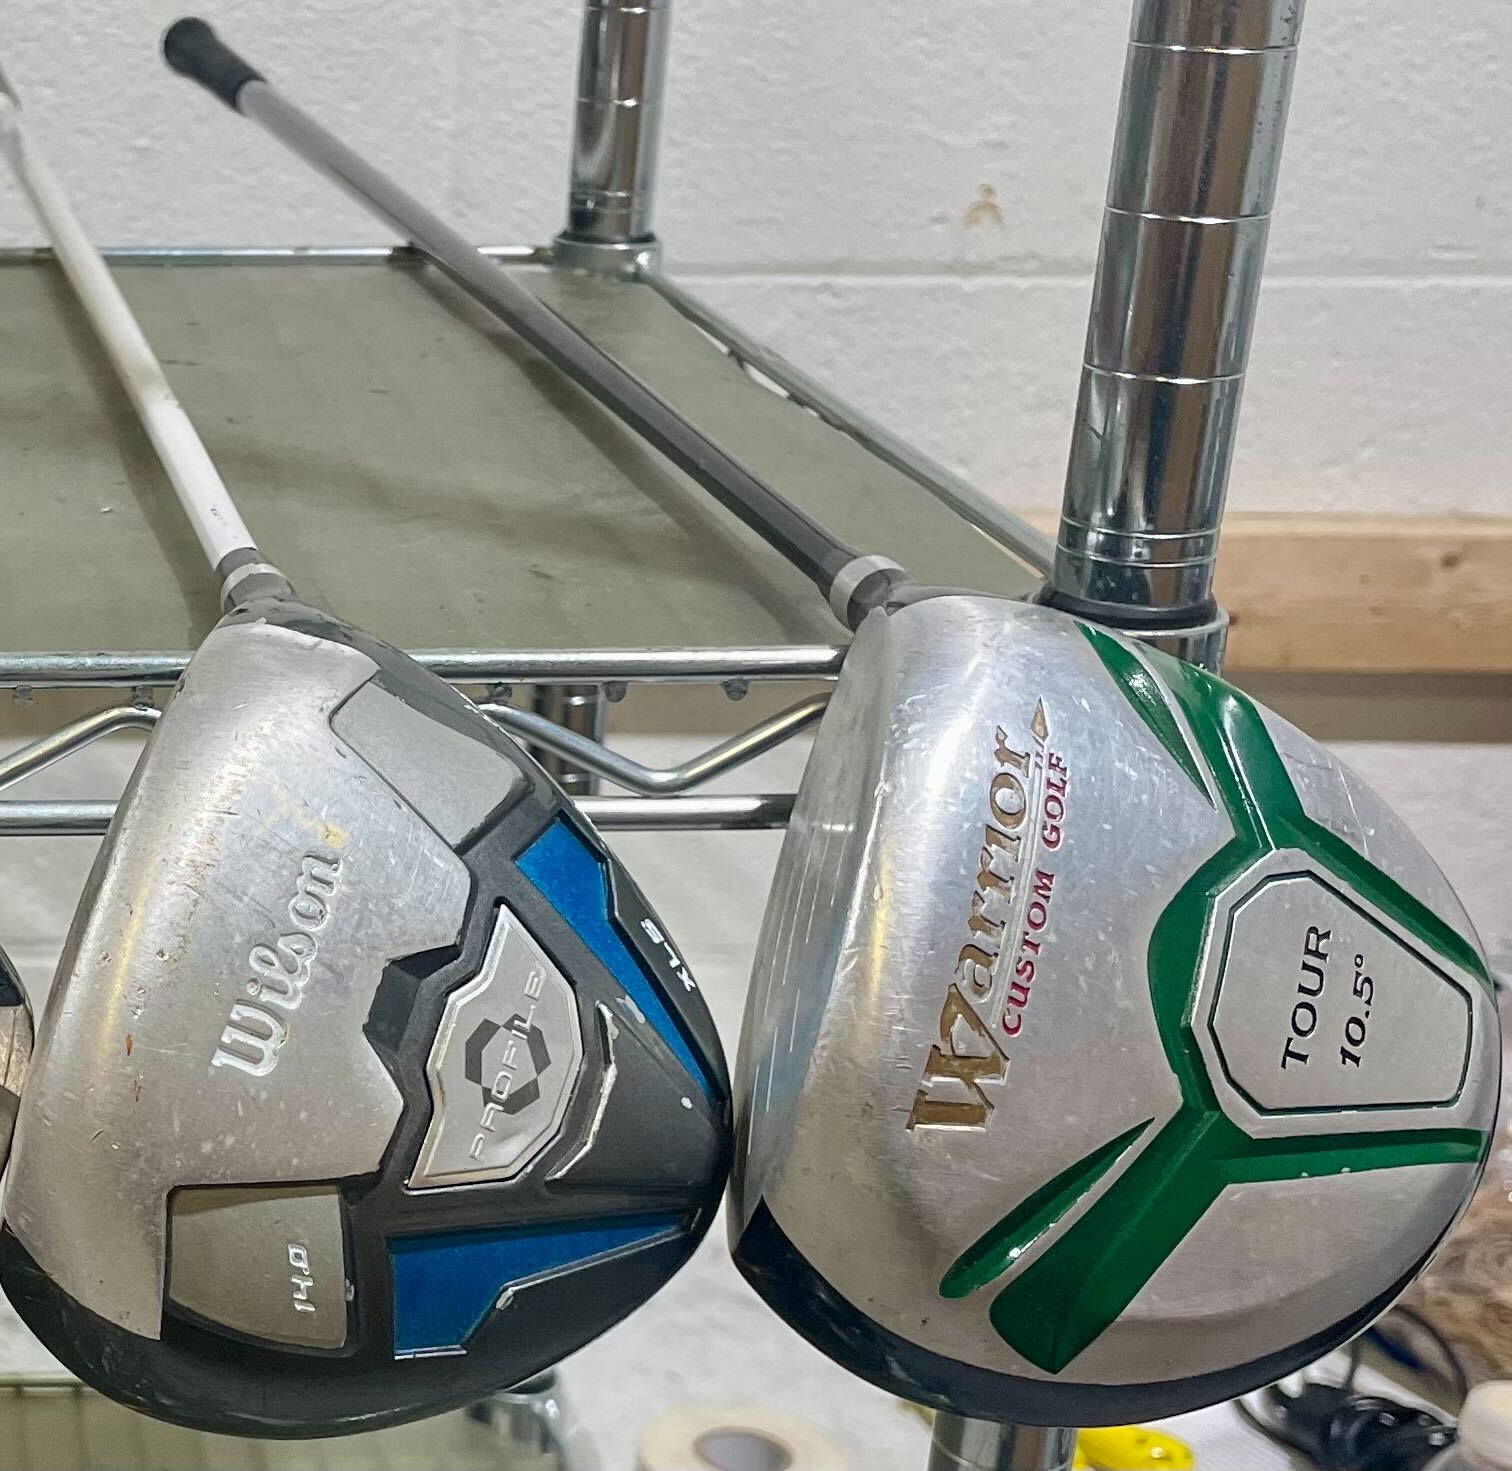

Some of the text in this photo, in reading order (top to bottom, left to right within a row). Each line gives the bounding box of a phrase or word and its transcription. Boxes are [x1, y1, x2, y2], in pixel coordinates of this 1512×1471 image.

[211, 852, 342, 1077] Wilson
[640, 918, 696, 992] XLS
[906, 725, 1032, 1132] Warrior
[1001, 752, 1069, 1037] CUSTOM GOLF
[1281, 926, 1332, 1069] TOUR
[469, 967, 546, 1160] PROFILE
